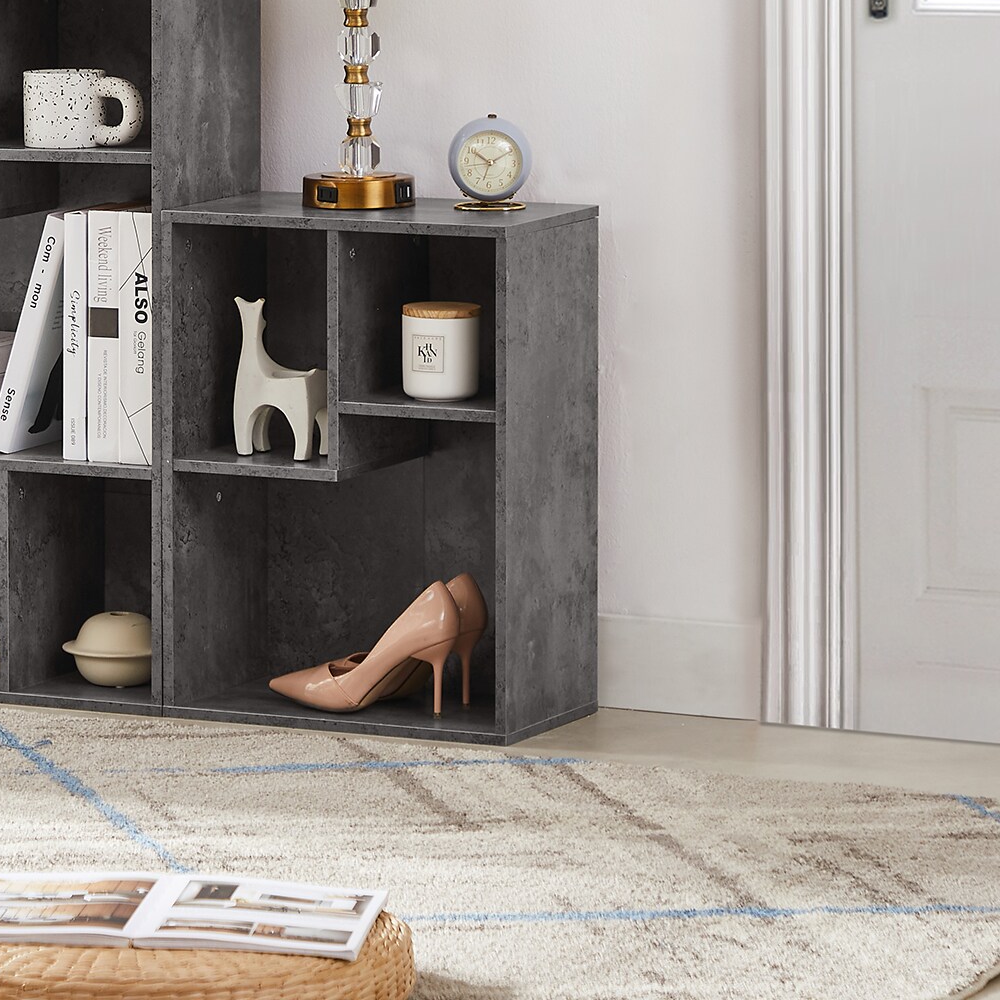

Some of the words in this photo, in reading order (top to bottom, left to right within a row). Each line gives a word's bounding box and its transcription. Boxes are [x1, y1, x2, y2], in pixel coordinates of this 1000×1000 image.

[467, 146, 476, 154] 10
[476, 138, 484, 146] 11
[486, 136, 496, 145] 12
[463, 157, 469, 165] 9
[475, 177, 481, 185] 7
[486, 181, 492, 189] 6
[498, 179, 503, 187] 5
[42, 236, 56, 263] Com
[97, 226, 113, 271] Weekend
[30, 283, 42, 309] mon
[93, 274, 112, 303] living
[135, 271, 148, 324] ALSO
[66, 290, 80, 357] Simplicity
[134, 331, 147, 374] Gelang
[0, 387, 16, 422] Sense
